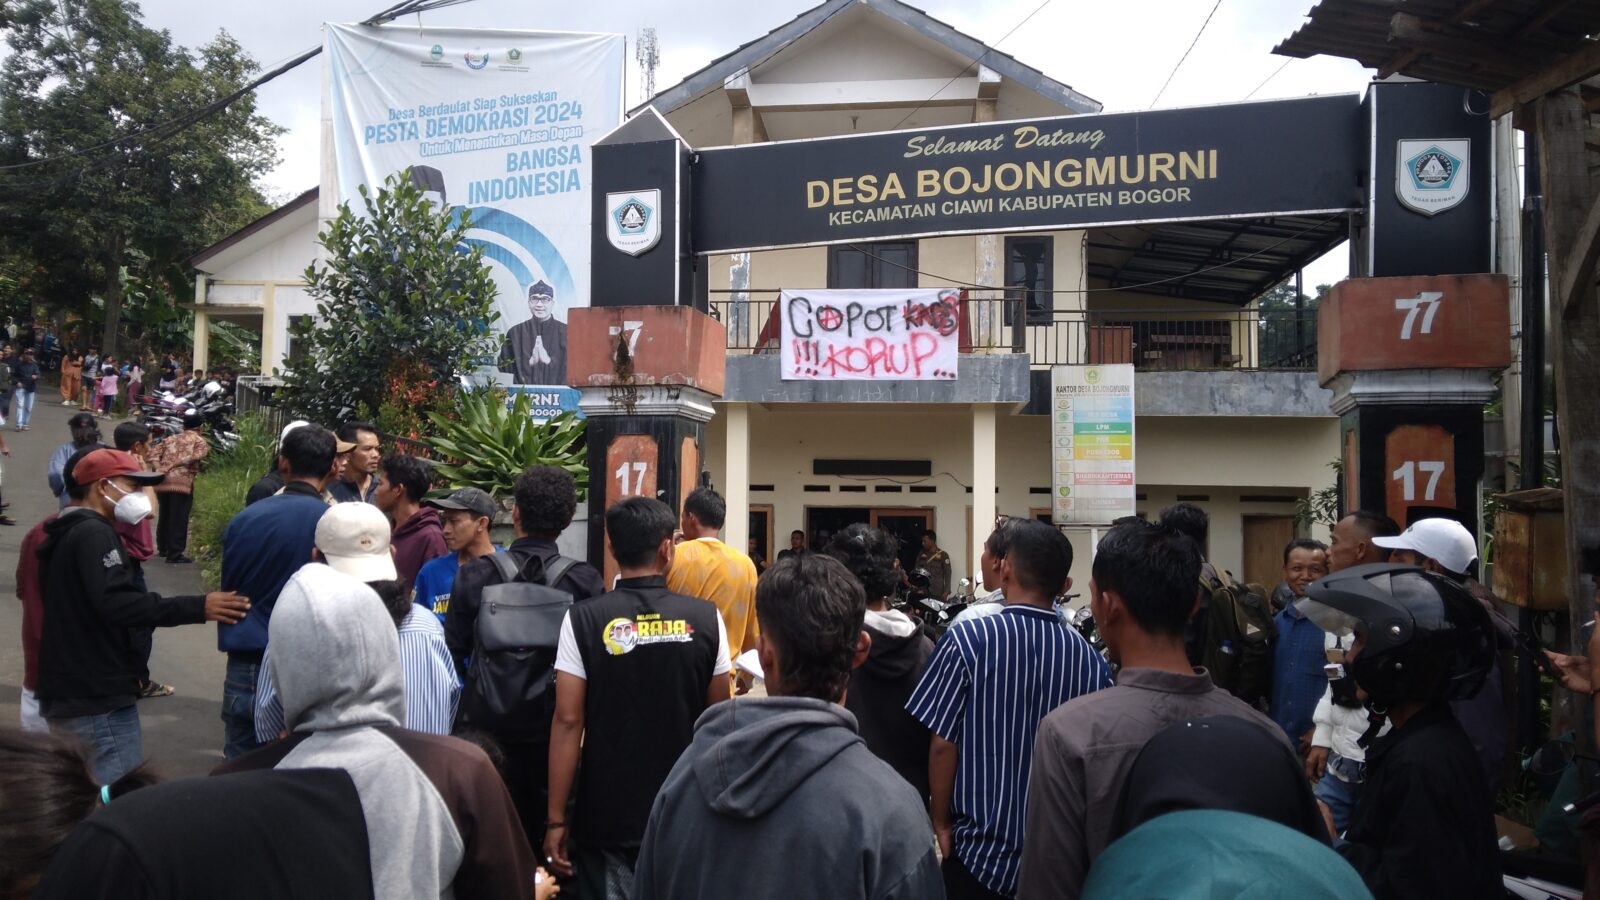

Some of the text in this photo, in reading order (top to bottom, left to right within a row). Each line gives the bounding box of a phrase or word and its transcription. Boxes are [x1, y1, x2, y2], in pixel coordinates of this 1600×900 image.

[364, 100, 583, 145] PESTA DEMOKRASI 2024
[389, 91, 557, 121] Desa Berdaulat Siap Sukseskan
[419, 125, 583, 157] Untuk Menentukan Masa Depan
[506, 144, 582, 173] BANGSA
[903, 126, 1106, 159] Selamat Datang
[468, 168, 581, 204] INDONESIA
[806, 149, 1219, 209] DESA BOJONGMURNI
[828, 187, 1192, 226] KECAMATAN CIAWI KABUPATEN BOGOR
[1395, 292, 1443, 340] 77
[615, 461, 648, 496] 17
[1393, 461, 1445, 501] 17
[637, 619, 686, 636] RAJA
